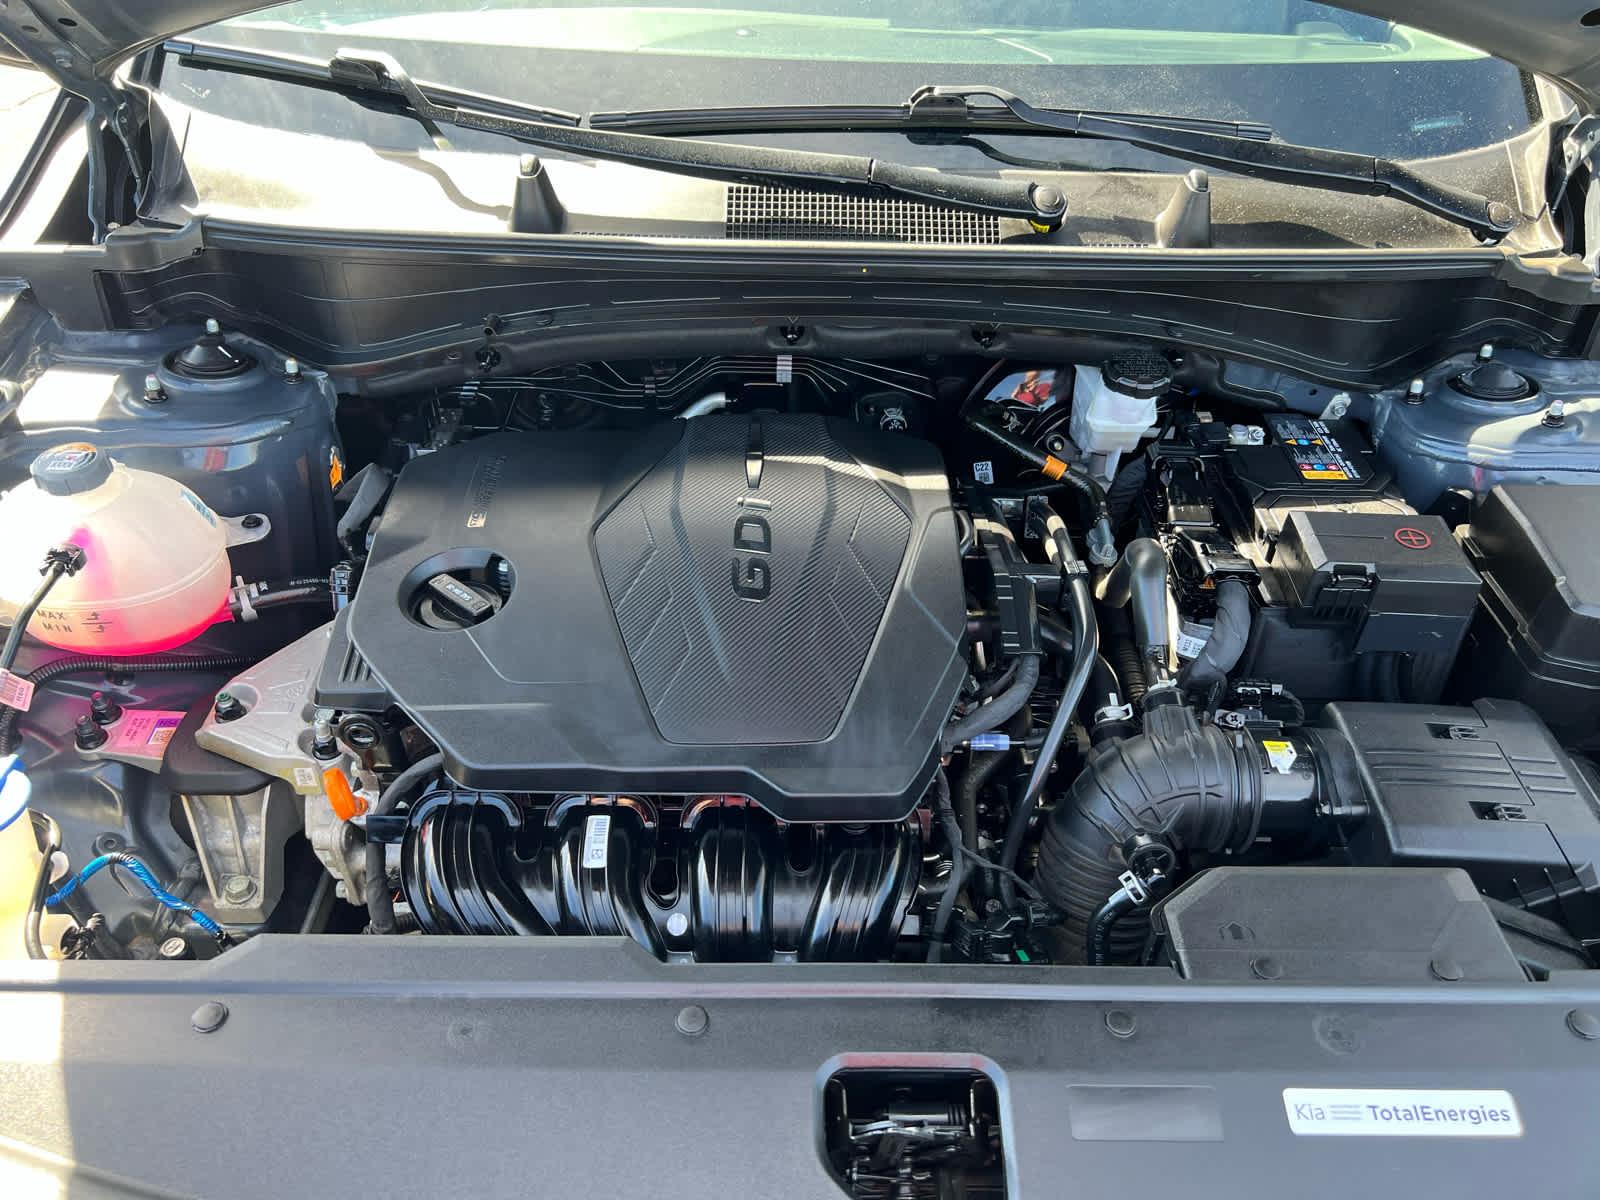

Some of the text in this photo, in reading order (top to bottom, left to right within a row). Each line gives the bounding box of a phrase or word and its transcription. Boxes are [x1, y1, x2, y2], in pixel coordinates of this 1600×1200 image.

[975, 463, 989, 472] C22
[731, 496, 772, 603] GDi
[36, 609, 66, 620] MAX
[42, 622, 73, 633] MIN
[1293, 1103, 1511, 1125] Kia TotalEnergies
